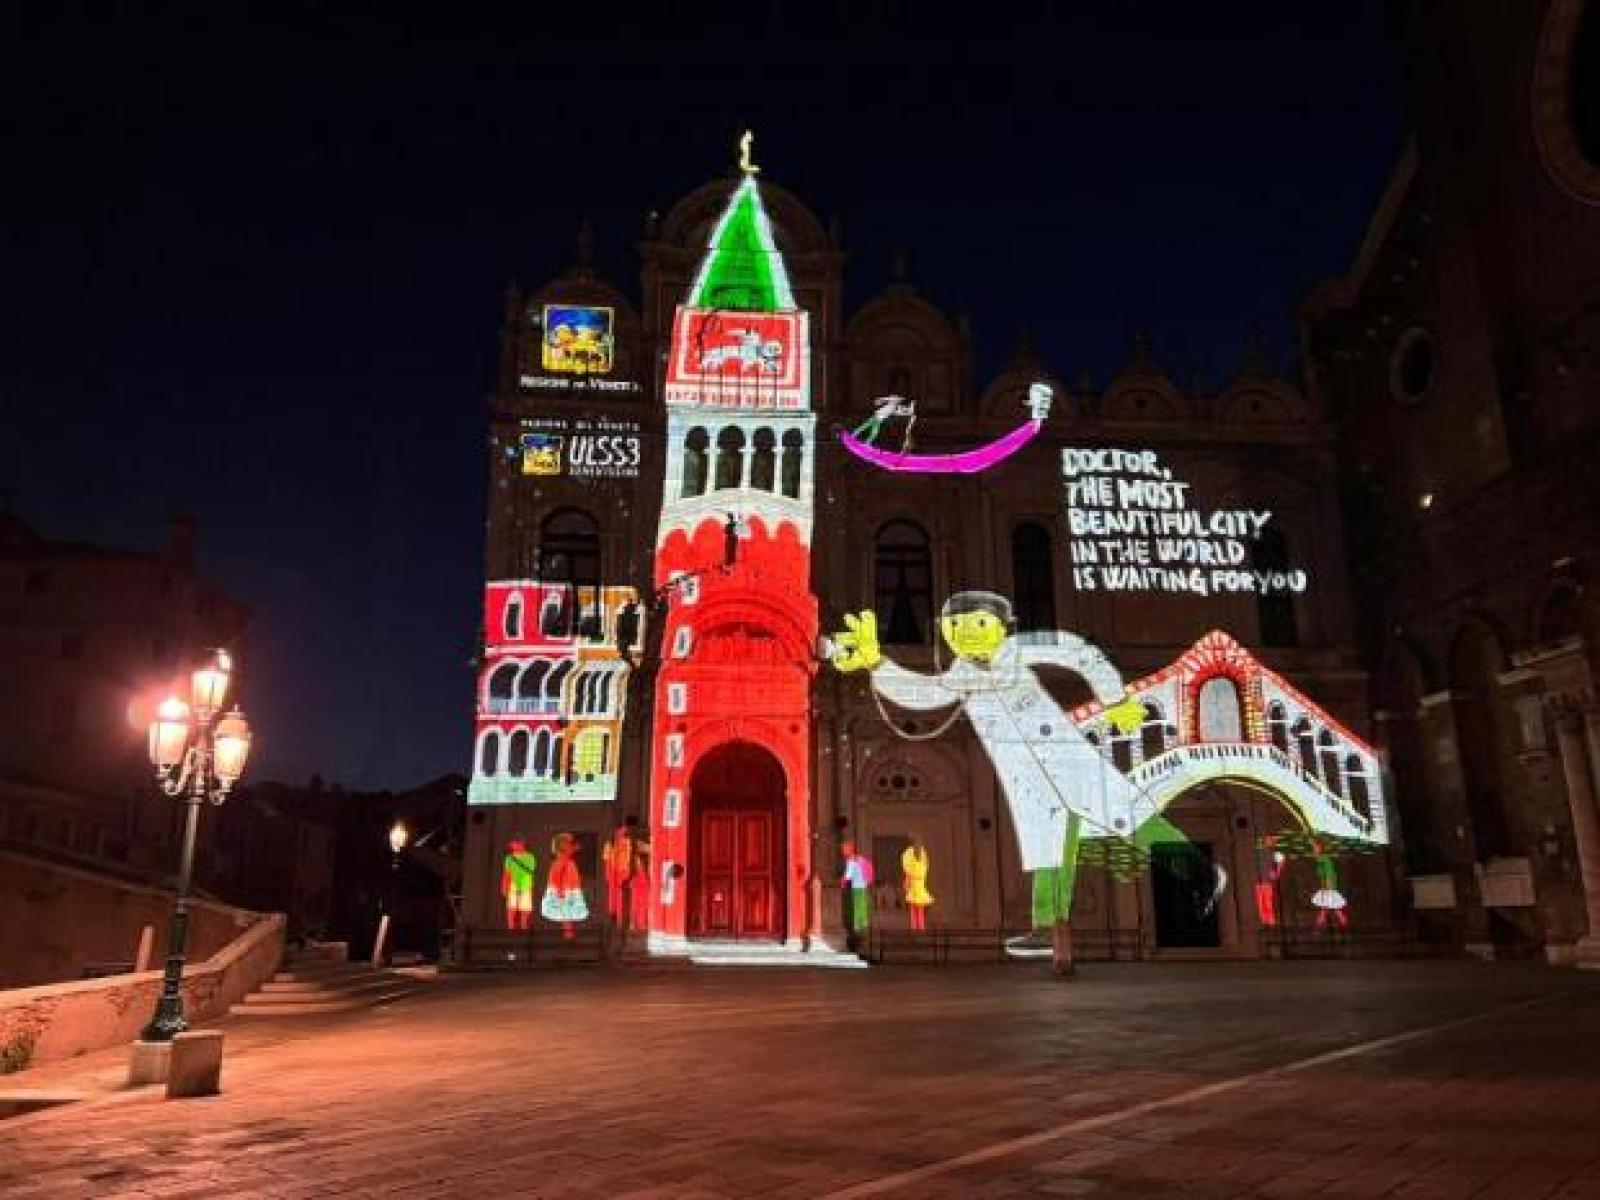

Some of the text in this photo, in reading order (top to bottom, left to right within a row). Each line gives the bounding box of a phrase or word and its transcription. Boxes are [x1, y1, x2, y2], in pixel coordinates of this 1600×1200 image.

[1062, 448, 1172, 480] DOCTOR,
[1064, 476, 1190, 508] THE MOST
[1067, 508, 1272, 539] BEAUTIFUL CITY
[1070, 539, 1245, 565] IN THE WORLD
[1073, 567, 1095, 591] IS
[1101, 565, 1208, 597] WAITING
[1210, 569, 1255, 592] FOR
